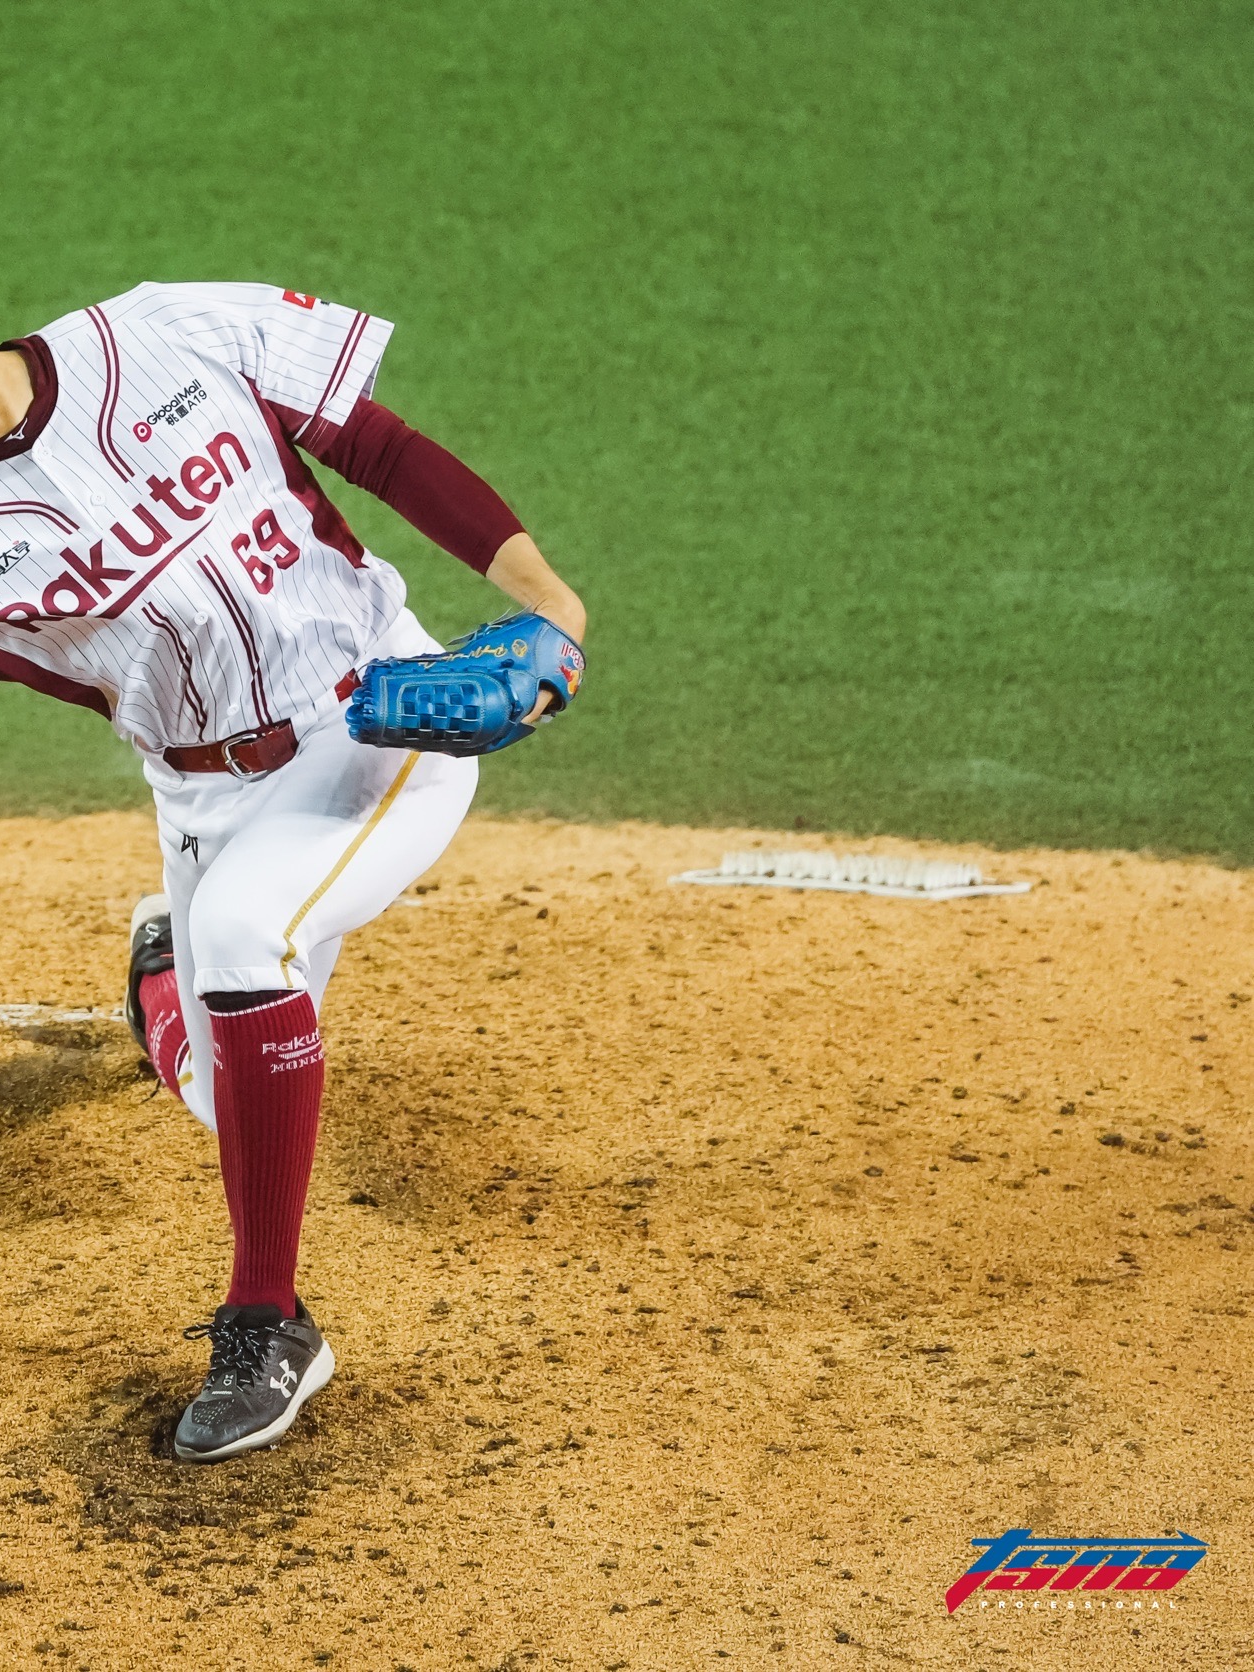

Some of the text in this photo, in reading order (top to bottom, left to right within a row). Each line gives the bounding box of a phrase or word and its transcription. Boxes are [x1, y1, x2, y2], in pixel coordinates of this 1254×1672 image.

[146, 394, 181, 426] Global
[231, 508, 300, 595] 69
[262, 1027, 321, 1055] Rakut
